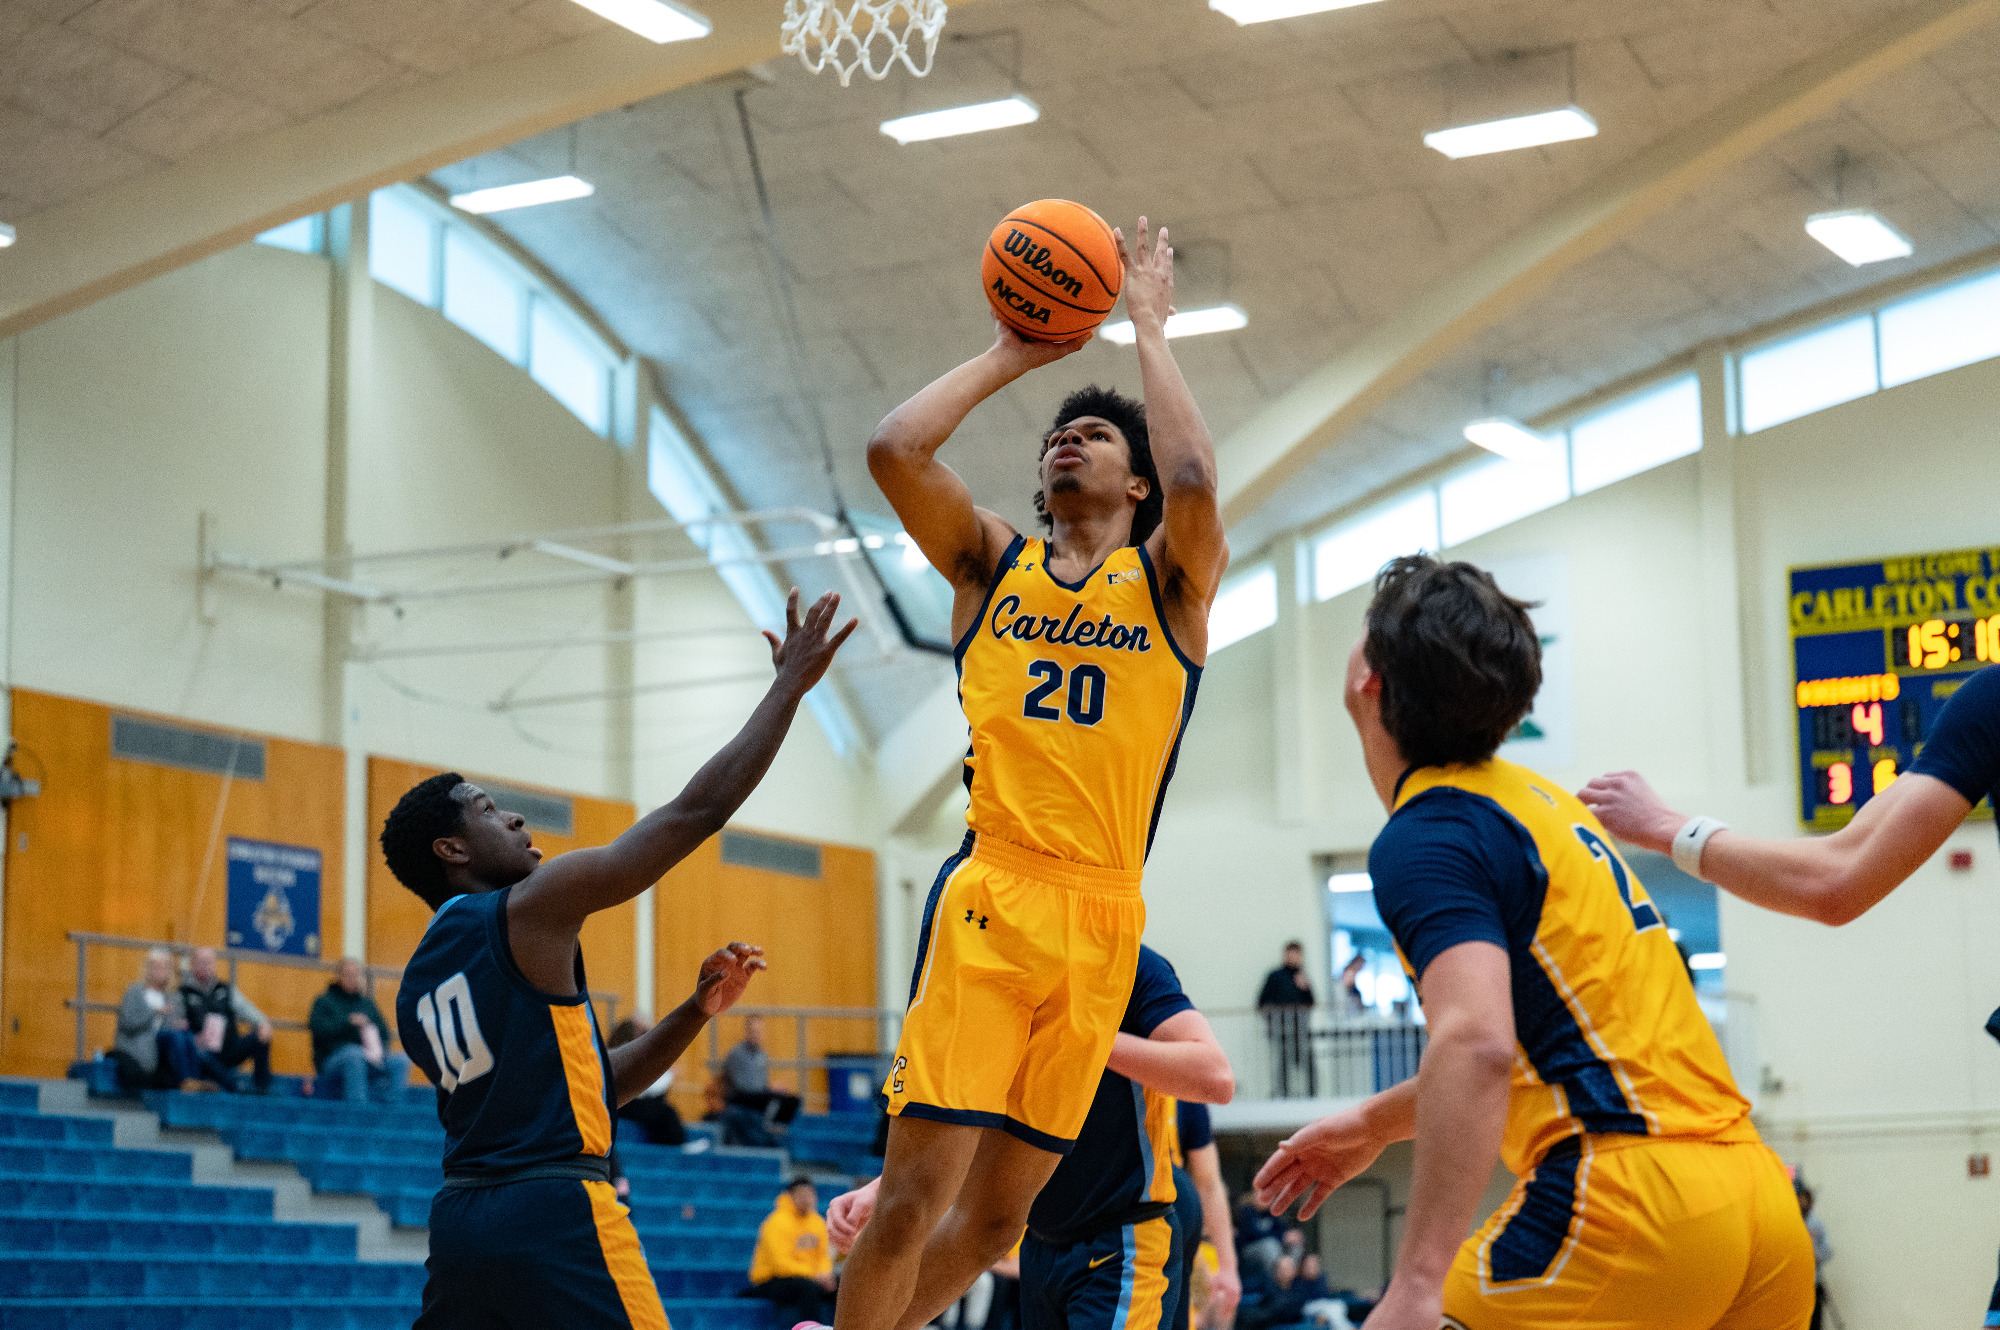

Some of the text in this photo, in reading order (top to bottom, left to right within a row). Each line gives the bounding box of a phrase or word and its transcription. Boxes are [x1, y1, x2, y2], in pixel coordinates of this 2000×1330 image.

[1003, 228, 1083, 298] Wilson
[992, 277, 1051, 324] NCAA
[991, 594, 1152, 652] Carleton
[1792, 579, 1956, 628] CARLETON
[1022, 658, 1107, 727] 20
[1851, 701, 1884, 746] 4
[1827, 762, 1852, 804] 3
[1570, 822, 1664, 935] 2
[416, 971, 495, 1095] 10
[892, 1056, 908, 1094] C
